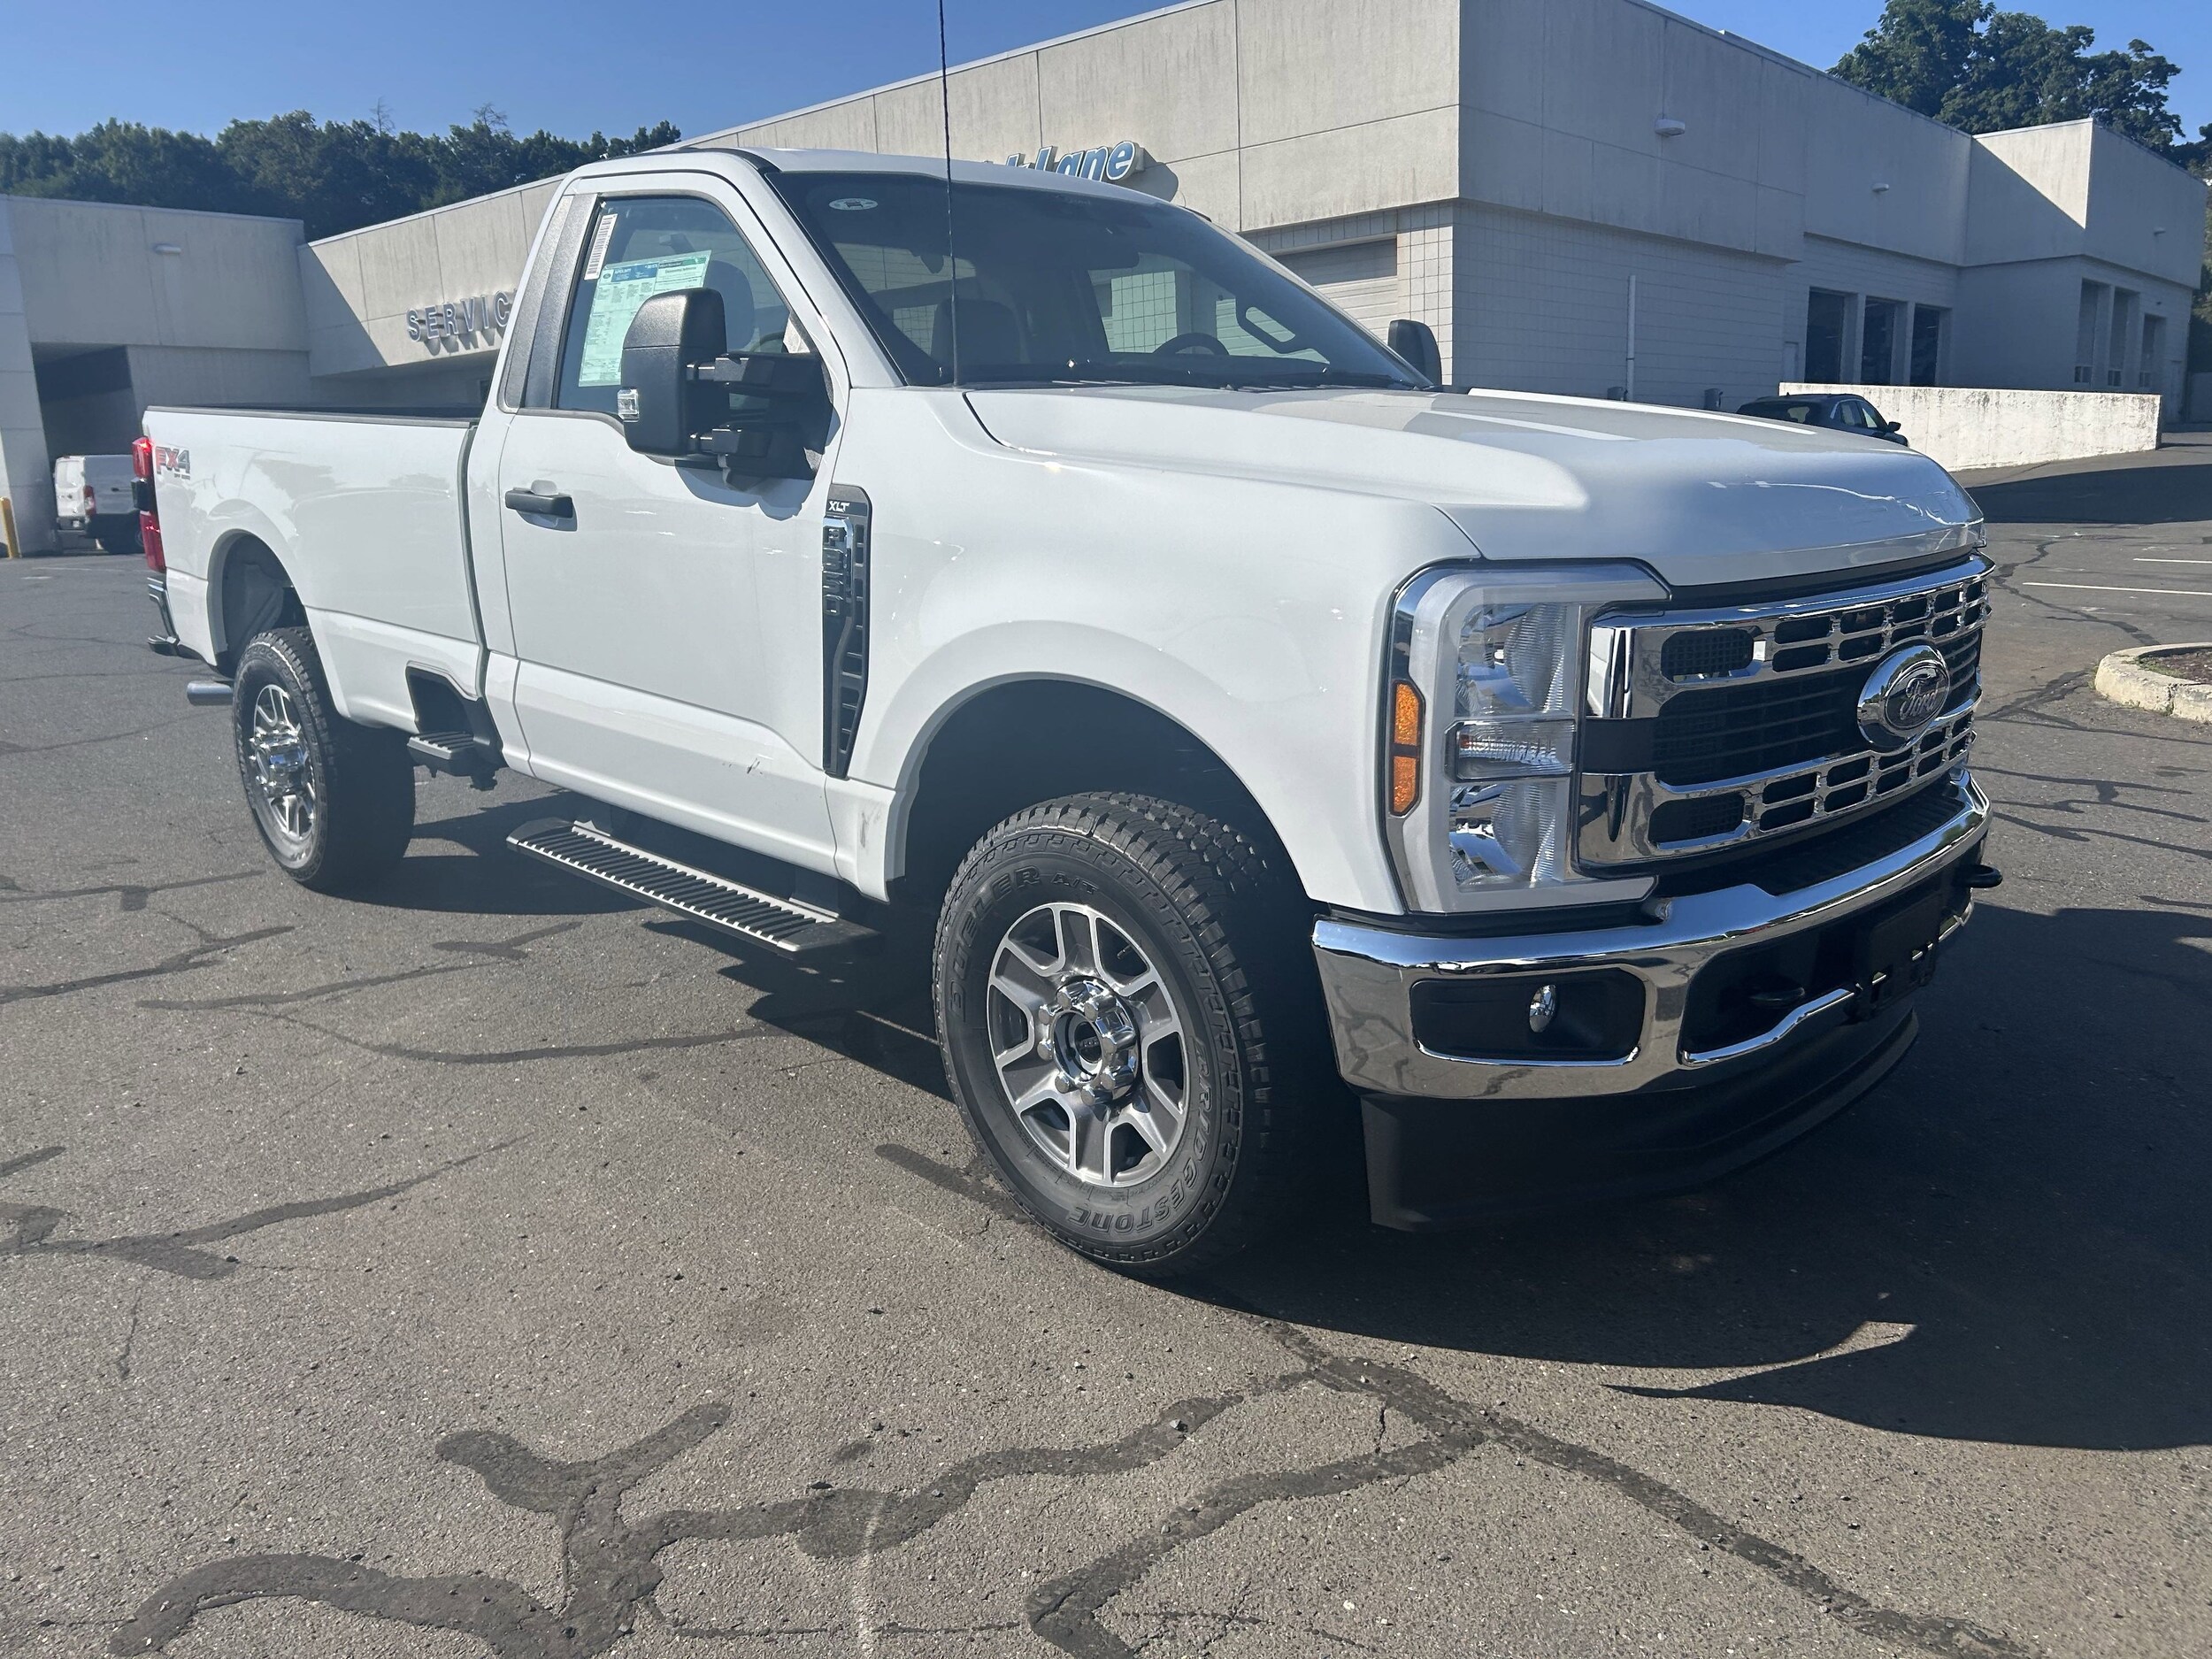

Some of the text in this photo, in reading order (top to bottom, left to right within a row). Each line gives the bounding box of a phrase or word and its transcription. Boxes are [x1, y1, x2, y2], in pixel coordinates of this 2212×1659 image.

[406, 289, 513, 342] SERVIC
[155, 446, 191, 475] FX4
[828, 500, 850, 513] XLT
[1899, 673, 1942, 721] Ford
